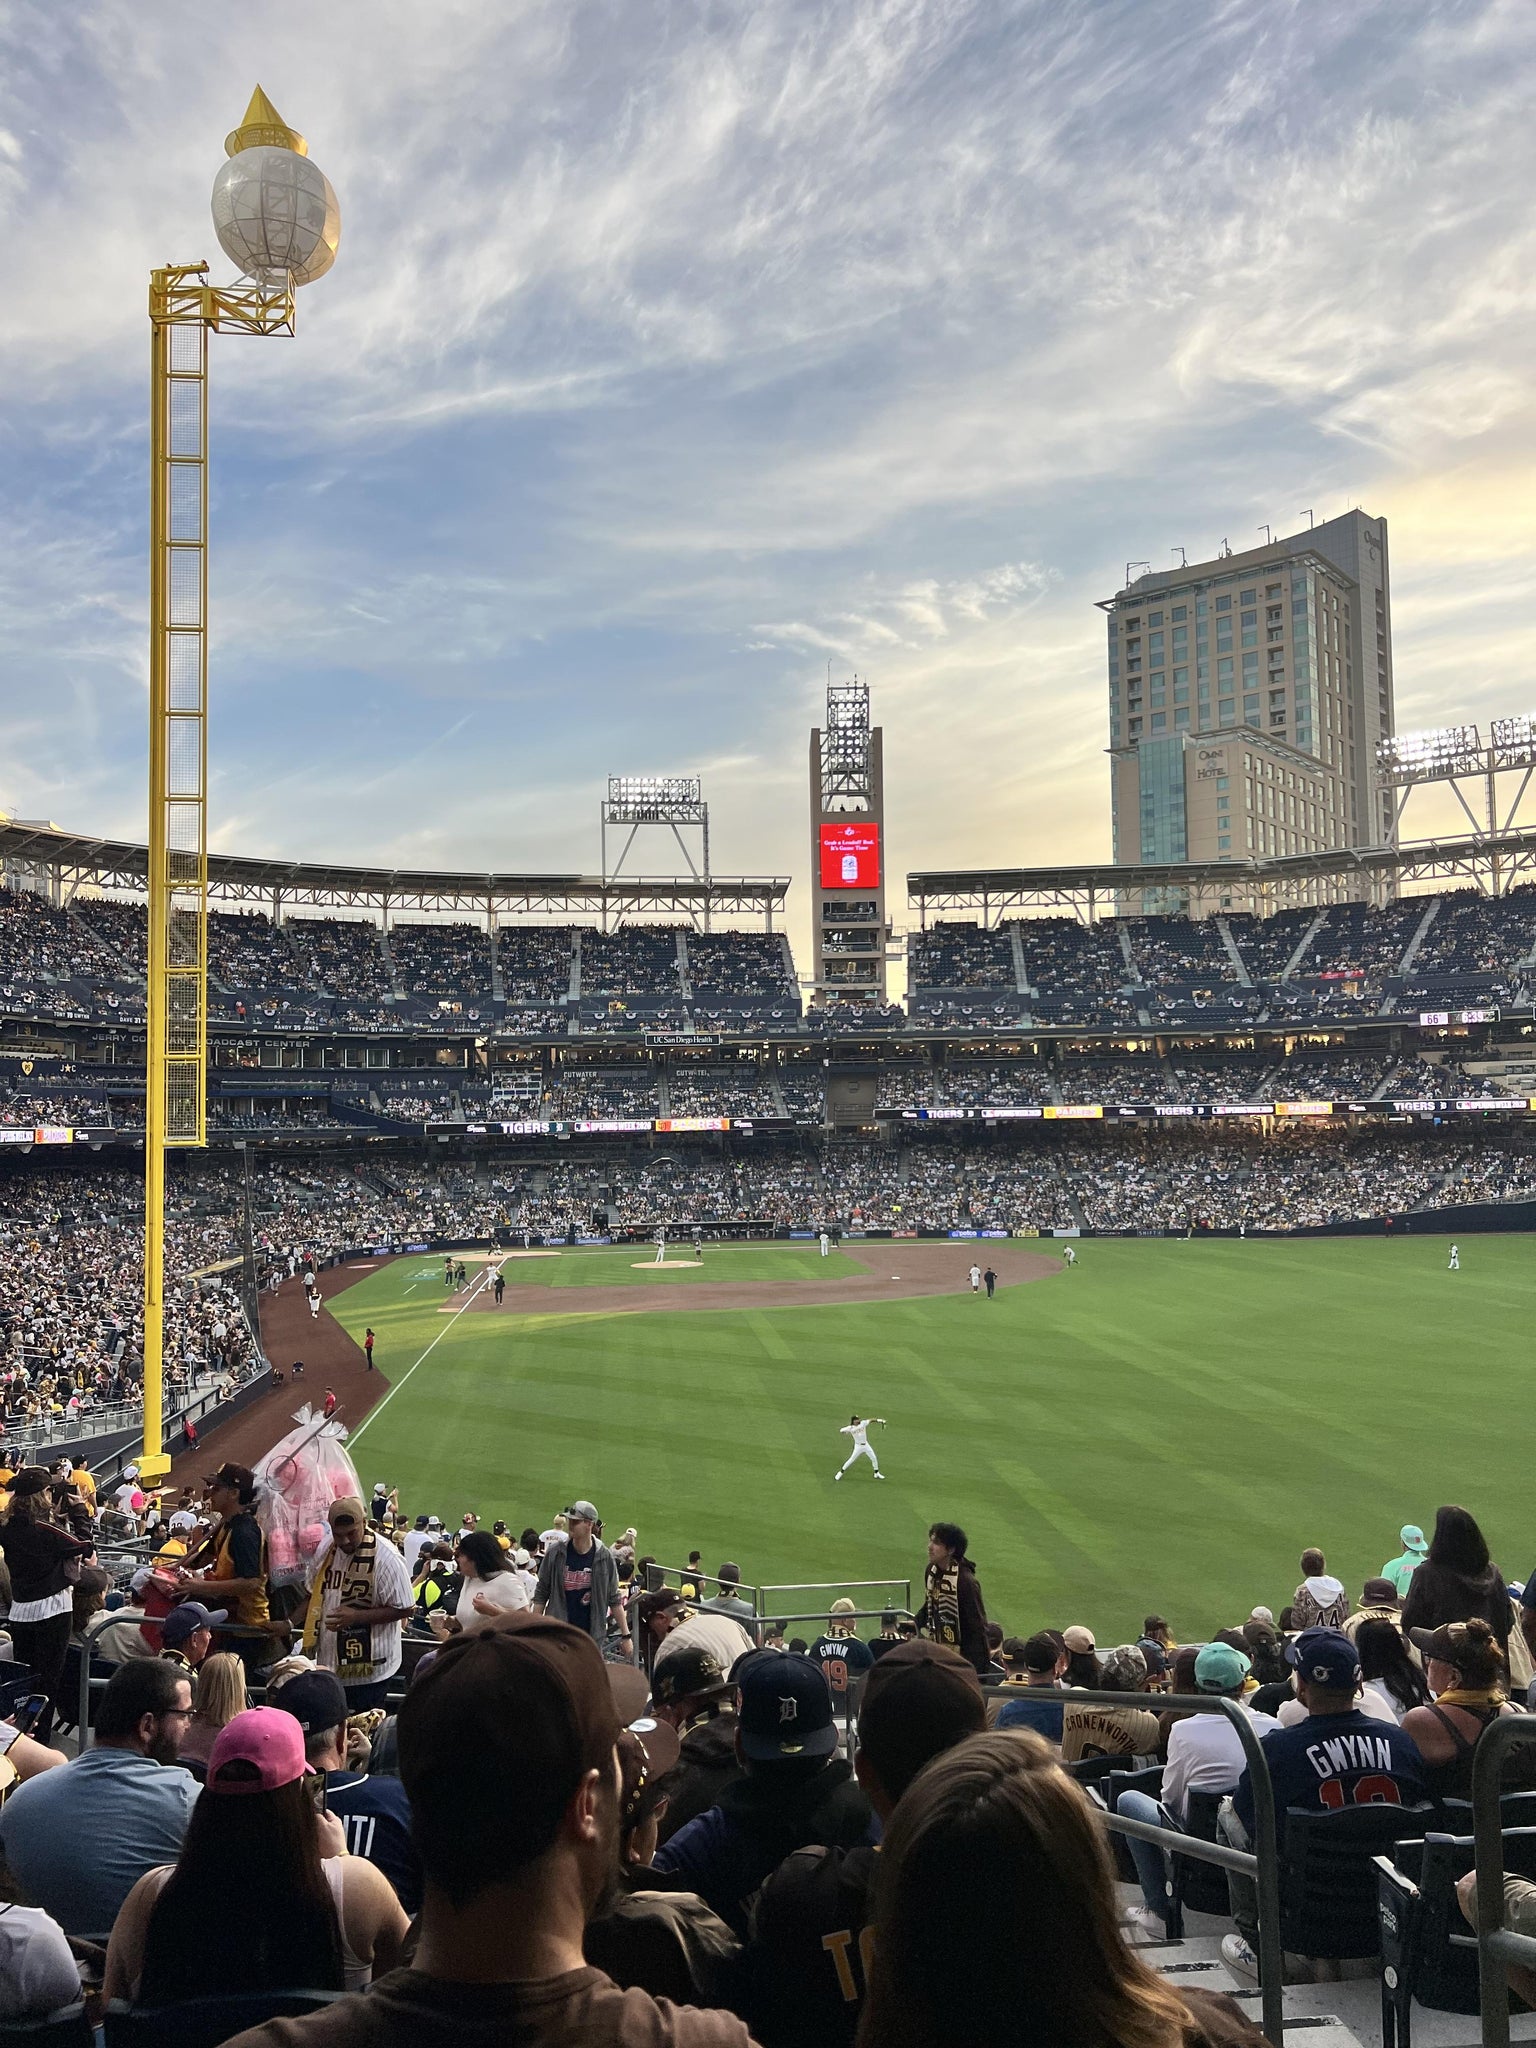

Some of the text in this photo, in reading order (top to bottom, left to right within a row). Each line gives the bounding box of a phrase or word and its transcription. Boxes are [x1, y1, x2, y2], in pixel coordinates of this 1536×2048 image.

[1197, 768, 1226, 778] HOTEL
[92, 1034, 127, 1042] JERRY
[265, 1040, 310, 1048] CENTER
[676, 1036, 693, 1044] Diego
[1154, 1107, 1194, 1115] TIGERS
[1393, 1101, 1436, 1111] TIGERS
[926, 1110, 964, 1118] TIGERS
[501, 1122, 550, 1134] TIGERS
[671, 1119, 722, 1130] PADRES
[345, 1638, 363, 1659] SD
[820, 1643, 849, 1658] GWYNN
[821, 1660, 848, 1692] 19
[778, 1696, 798, 1724] D
[1065, 1713, 1138, 1754] CRONENWORTH
[1306, 1735, 1392, 1778] GWYNN
